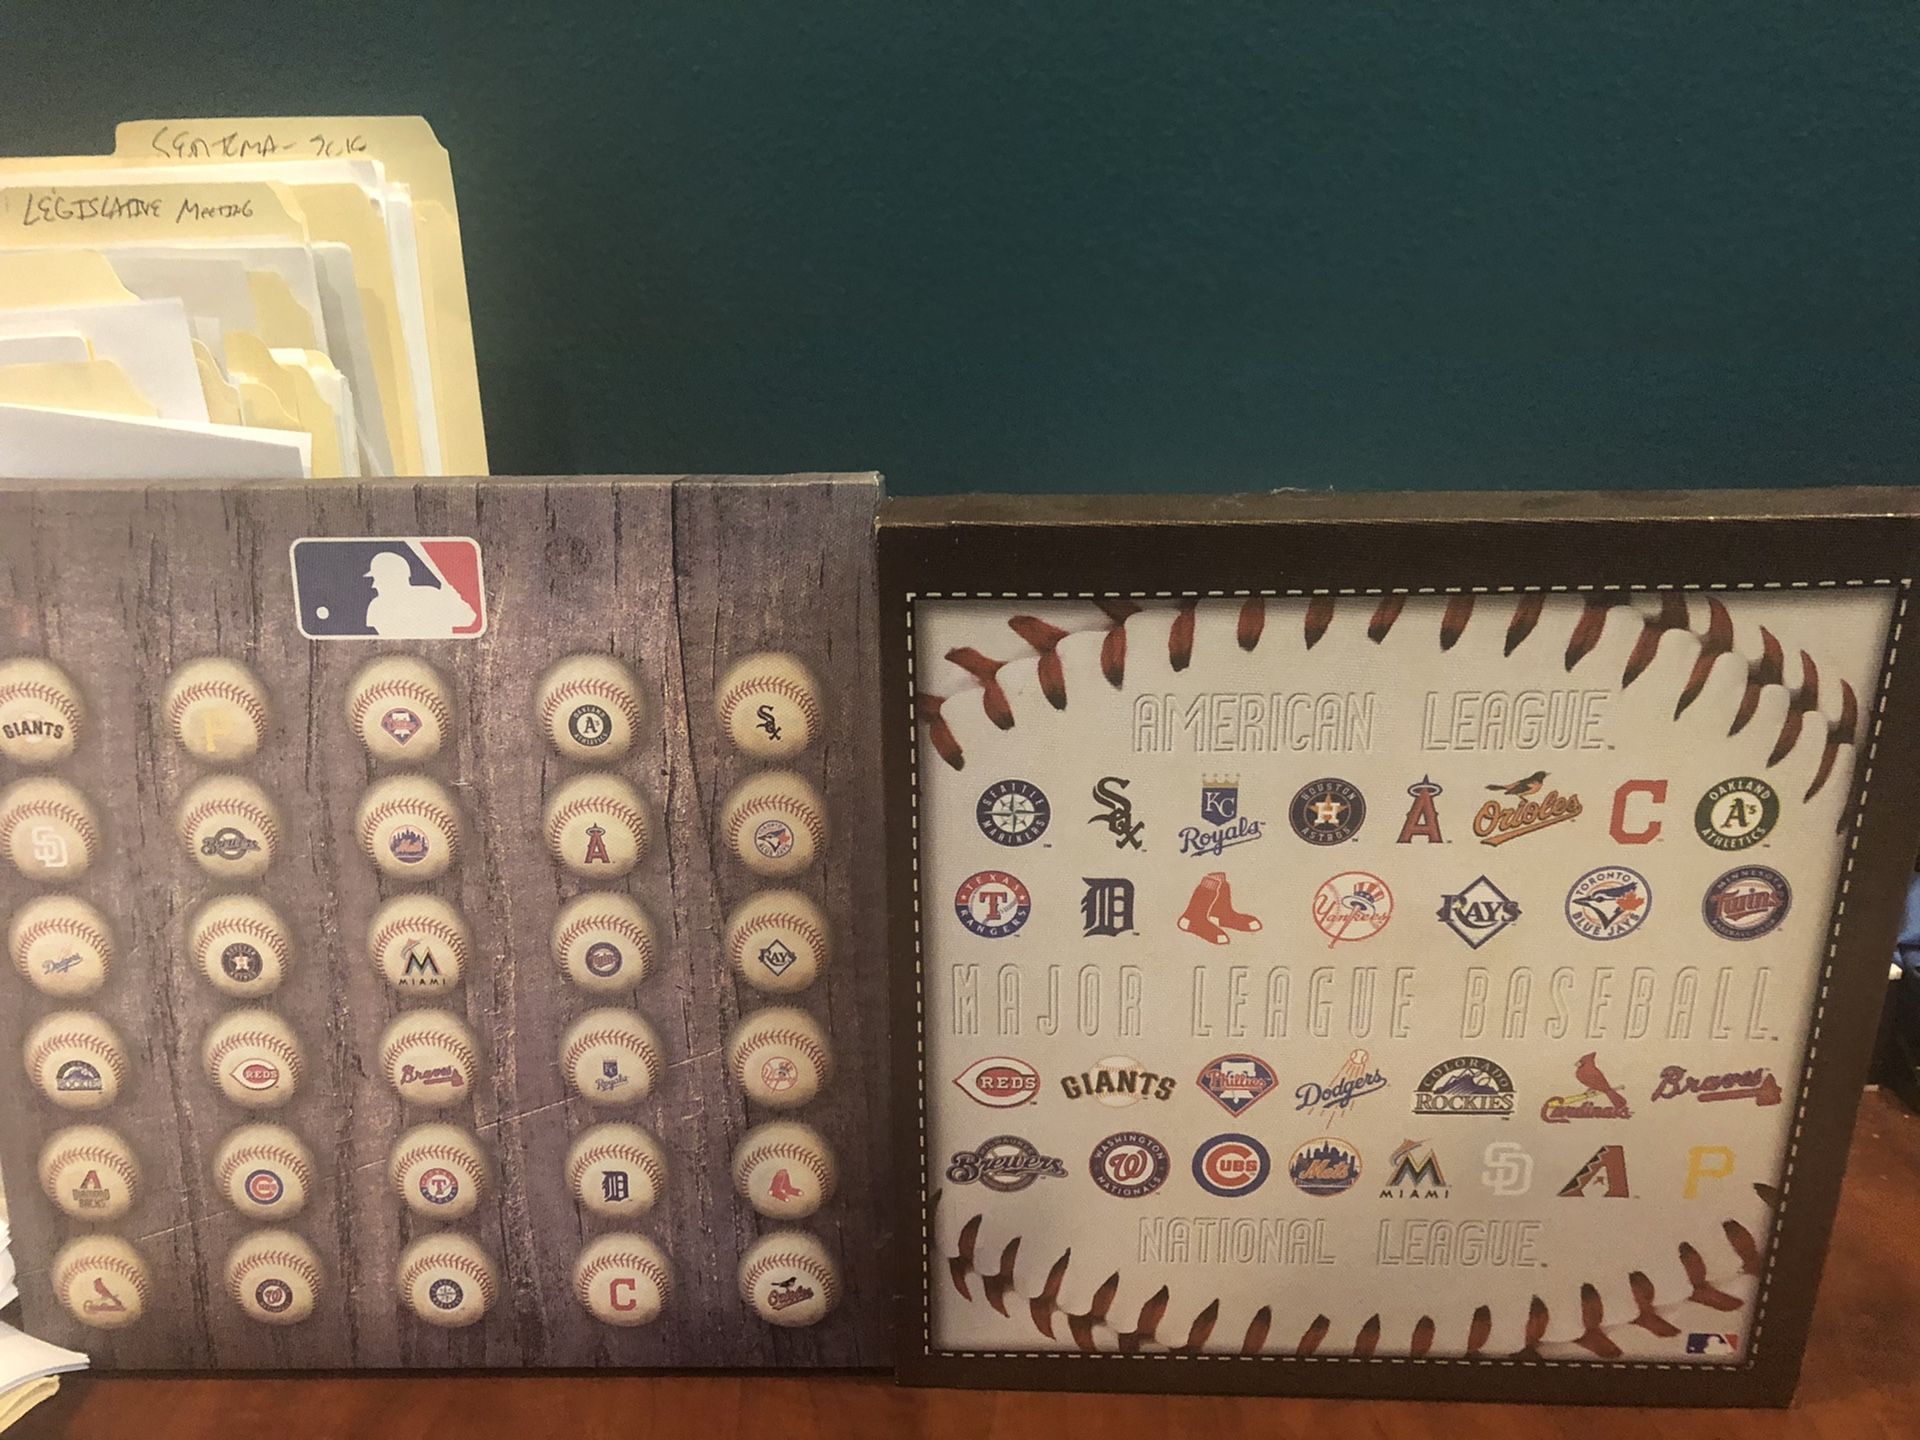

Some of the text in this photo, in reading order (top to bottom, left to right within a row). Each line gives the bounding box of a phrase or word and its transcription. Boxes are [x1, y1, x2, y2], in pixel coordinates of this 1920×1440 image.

[2, 720, 64, 740] GIANTS
[1133, 690, 1612, 752] AMERICAN LEAGUE
[982, 782, 1046, 806] SEATTLE
[1301, 781, 1358, 802] HOUSTON
[1708, 778, 1772, 802] OAKLAND
[1205, 791, 1236, 819] KC
[1396, 786, 1444, 844] A
[1473, 789, 1584, 841] Orioles
[1609, 779, 1668, 845] C
[980, 818, 1047, 845] MARINERS
[1178, 816, 1264, 858] Royals
[1301, 825, 1352, 845] ASTROS
[1700, 825, 1767, 849] ATHLETICS
[965, 873, 1020, 891] TEXAS
[1575, 870, 1632, 897] TORONTO
[979, 891, 1008, 921] T
[1080, 876, 1135, 938] D
[960, 909, 1027, 936] RANGERS
[1571, 911, 1641, 937] BLUE JAYS
[398, 978, 446, 986] MIAMI
[950, 962, 1773, 1041] MAJOR LEAGUE BASEBALL
[245, 1070, 278, 1080] REDS
[980, 1076, 1037, 1090] REDS
[1060, 1070, 1178, 1102] GIANTS
[1423, 1057, 1510, 1089] COLORADO
[1295, 1068, 1388, 1111] Dodgers
[1415, 1093, 1515, 1111] ROCKIES
[1095, 1133, 1166, 1161] WASHINGTON
[945, 1151, 1069, 1186] Brewers
[1683, 1145, 1736, 1201] P
[1096, 1174, 1163, 1197] NATIONALS
[1378, 1189, 1450, 1199] MIAMI
[1137, 1216, 1544, 1267] NATIONAL LEAGUE
[609, 1278, 637, 1312] C
